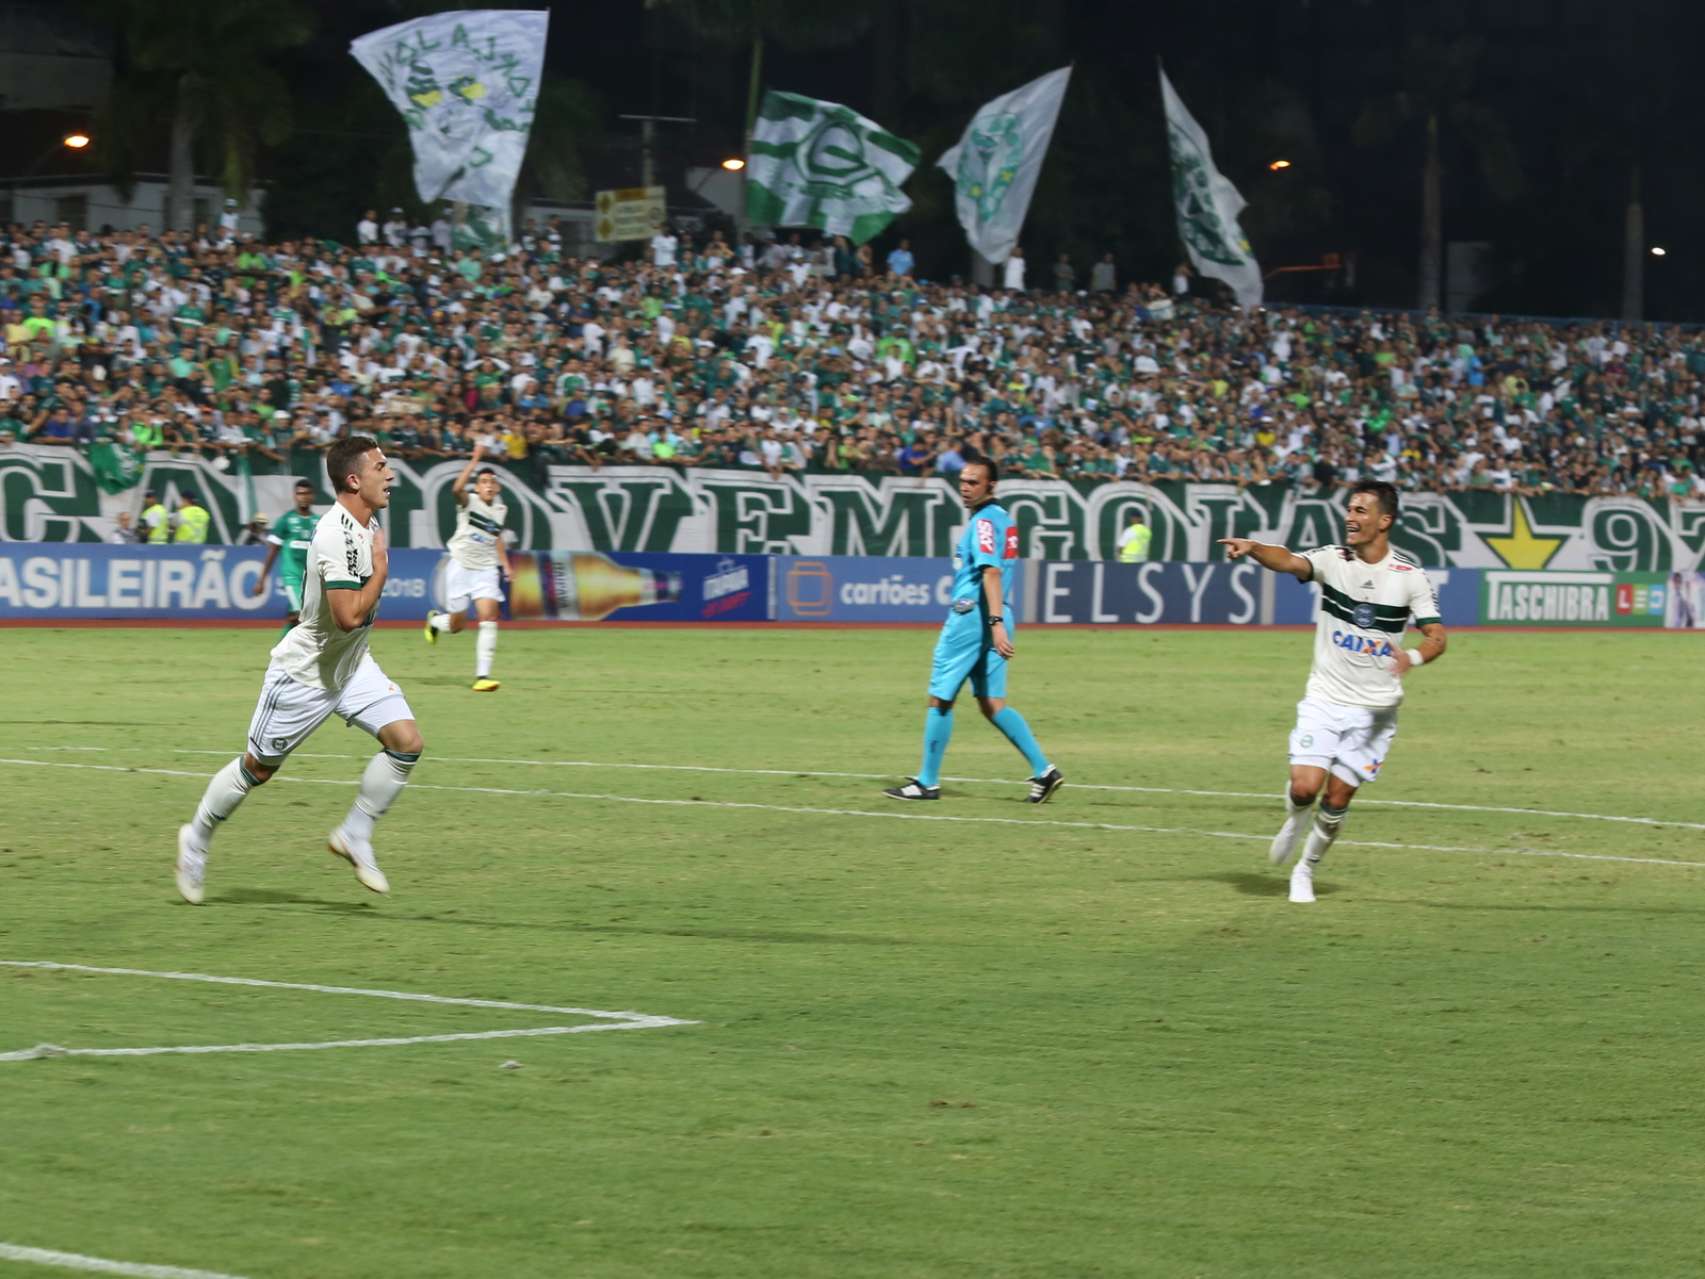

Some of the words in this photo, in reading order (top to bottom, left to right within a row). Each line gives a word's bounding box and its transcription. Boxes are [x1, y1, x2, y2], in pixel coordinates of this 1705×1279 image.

[840, 576, 930, 605] cartões
[1045, 562, 1256, 624] ELSYS
[1485, 571, 1614, 621] TASCHIBRA
[1617, 586, 1665, 612] LED
[1333, 630, 1393, 656] CAIXA
